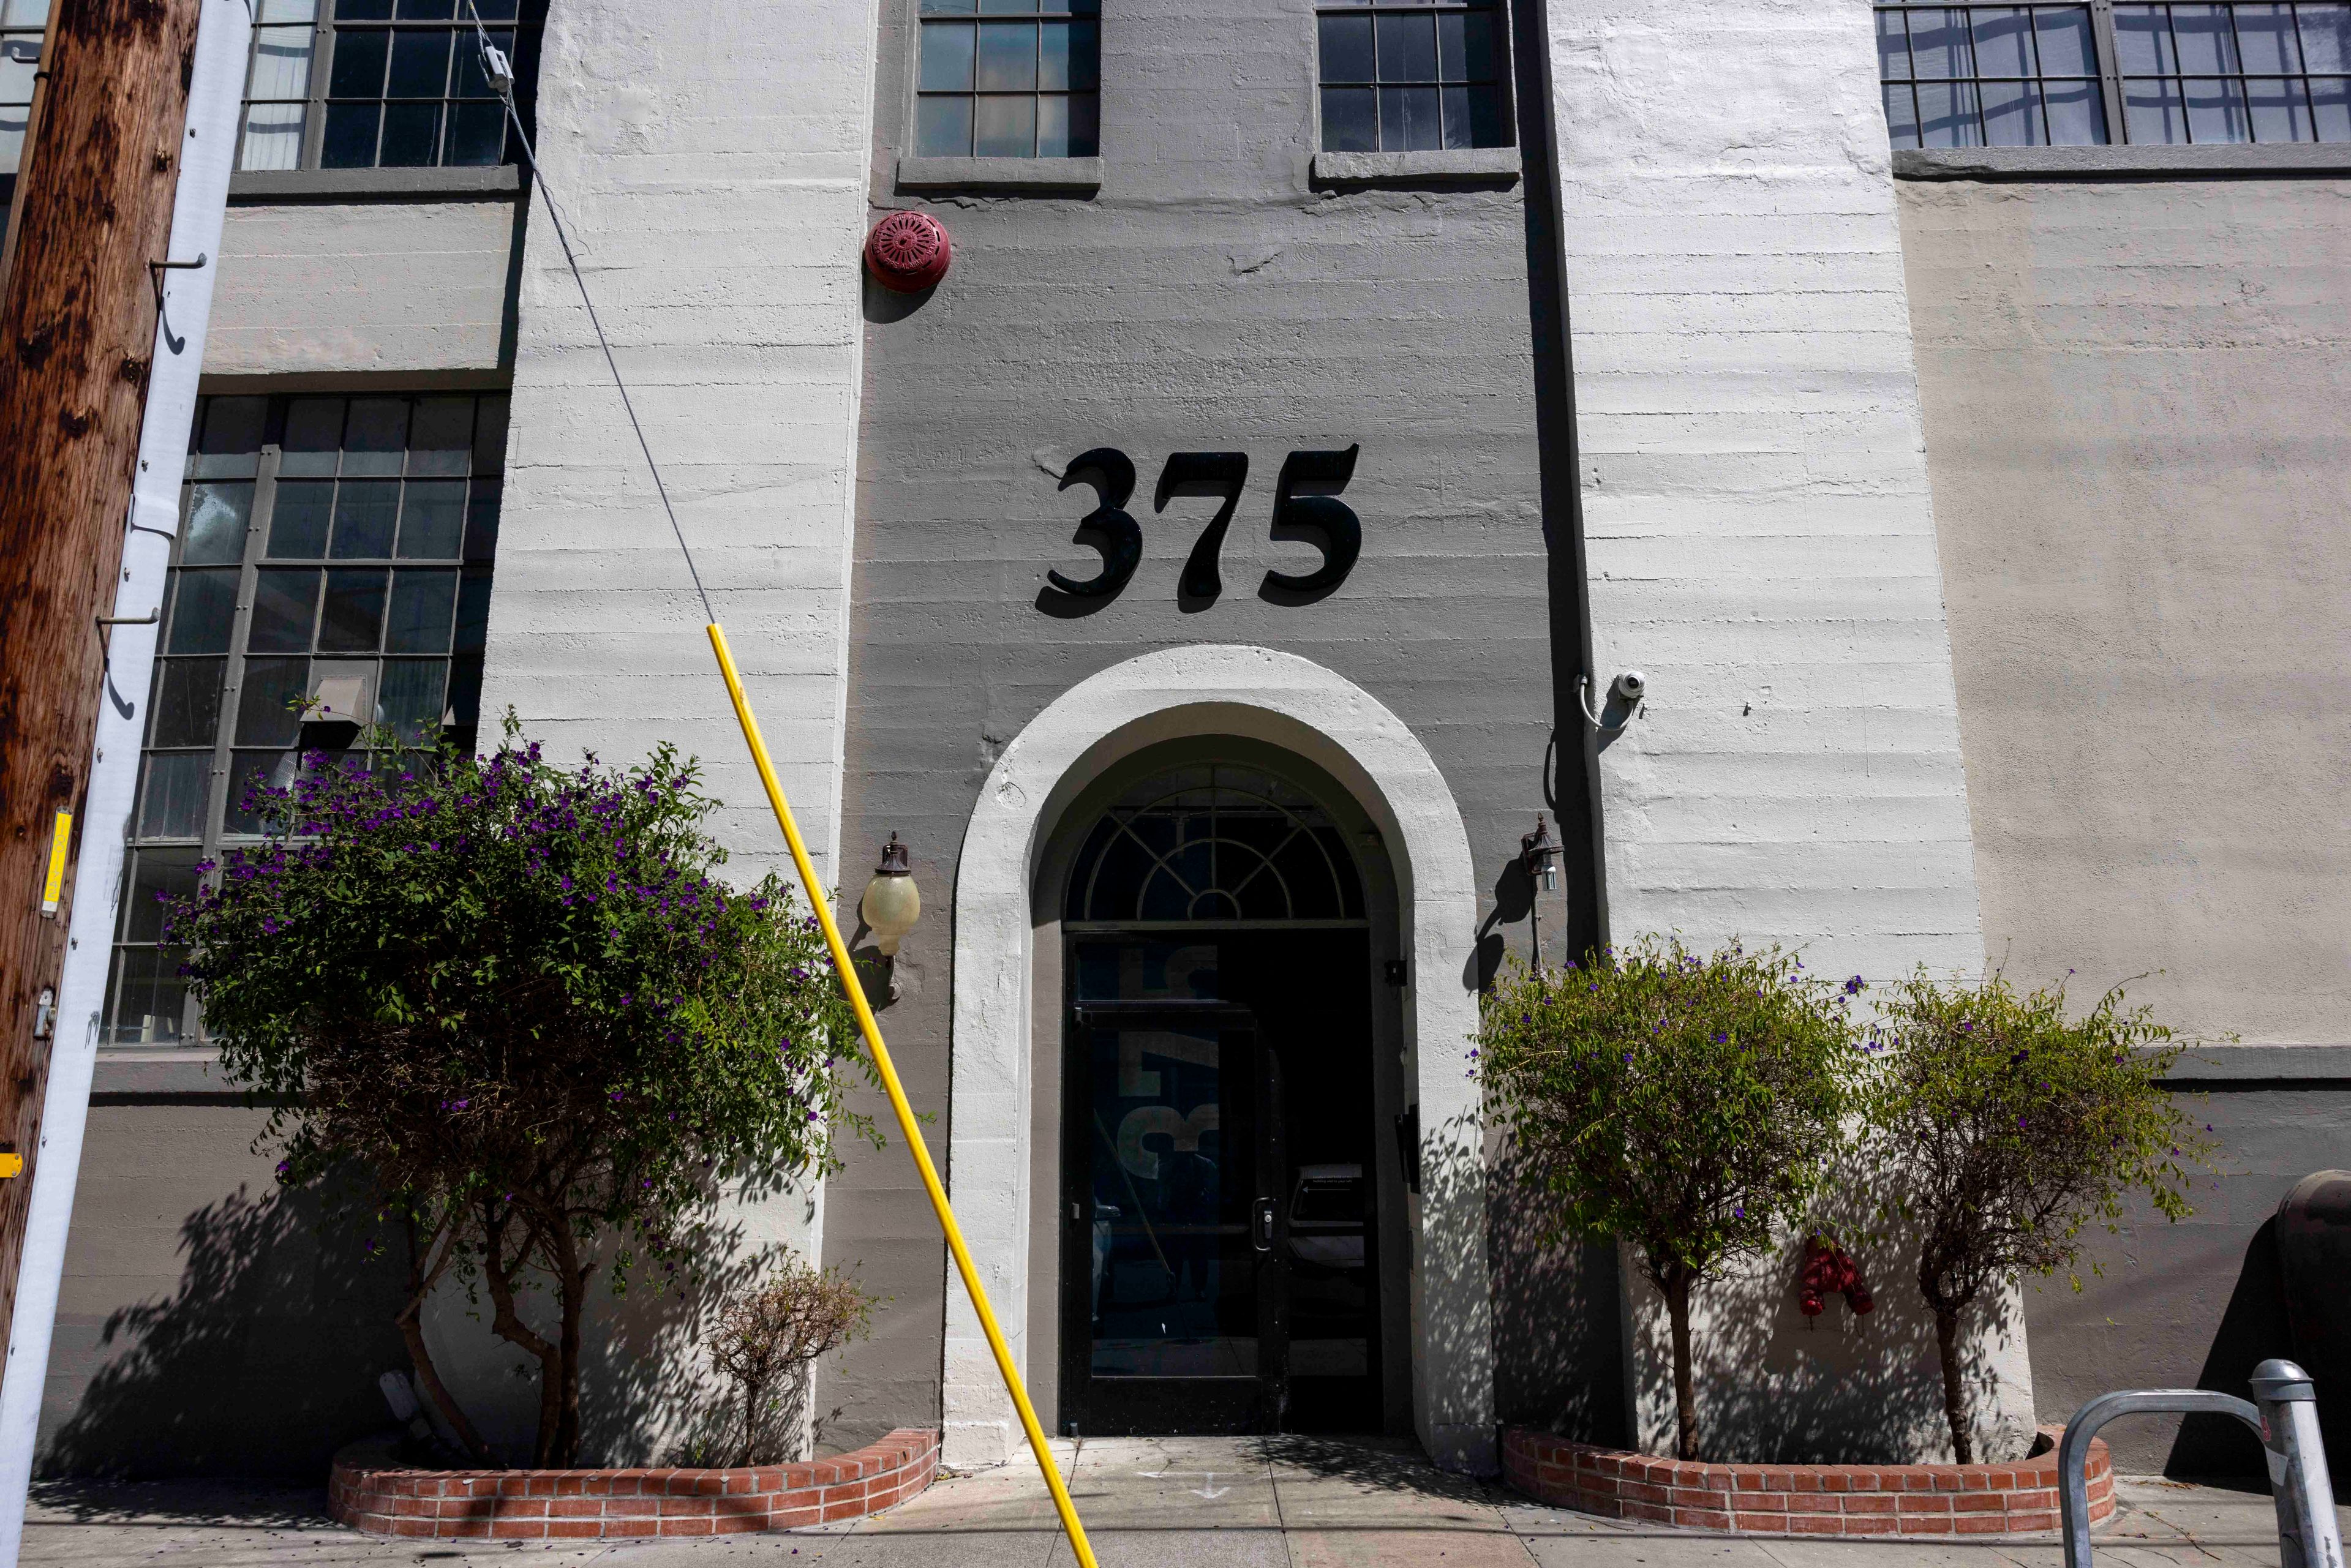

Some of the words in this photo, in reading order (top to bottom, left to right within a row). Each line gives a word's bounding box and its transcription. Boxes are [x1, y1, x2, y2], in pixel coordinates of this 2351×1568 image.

[891, 215, 923, 223] AUTOMATIC
[925, 225, 936, 256] SPRINKLER
[884, 258, 900, 269] FIRE
[901, 258, 924, 269] ALARM
[1046, 443, 1362, 598] 375
